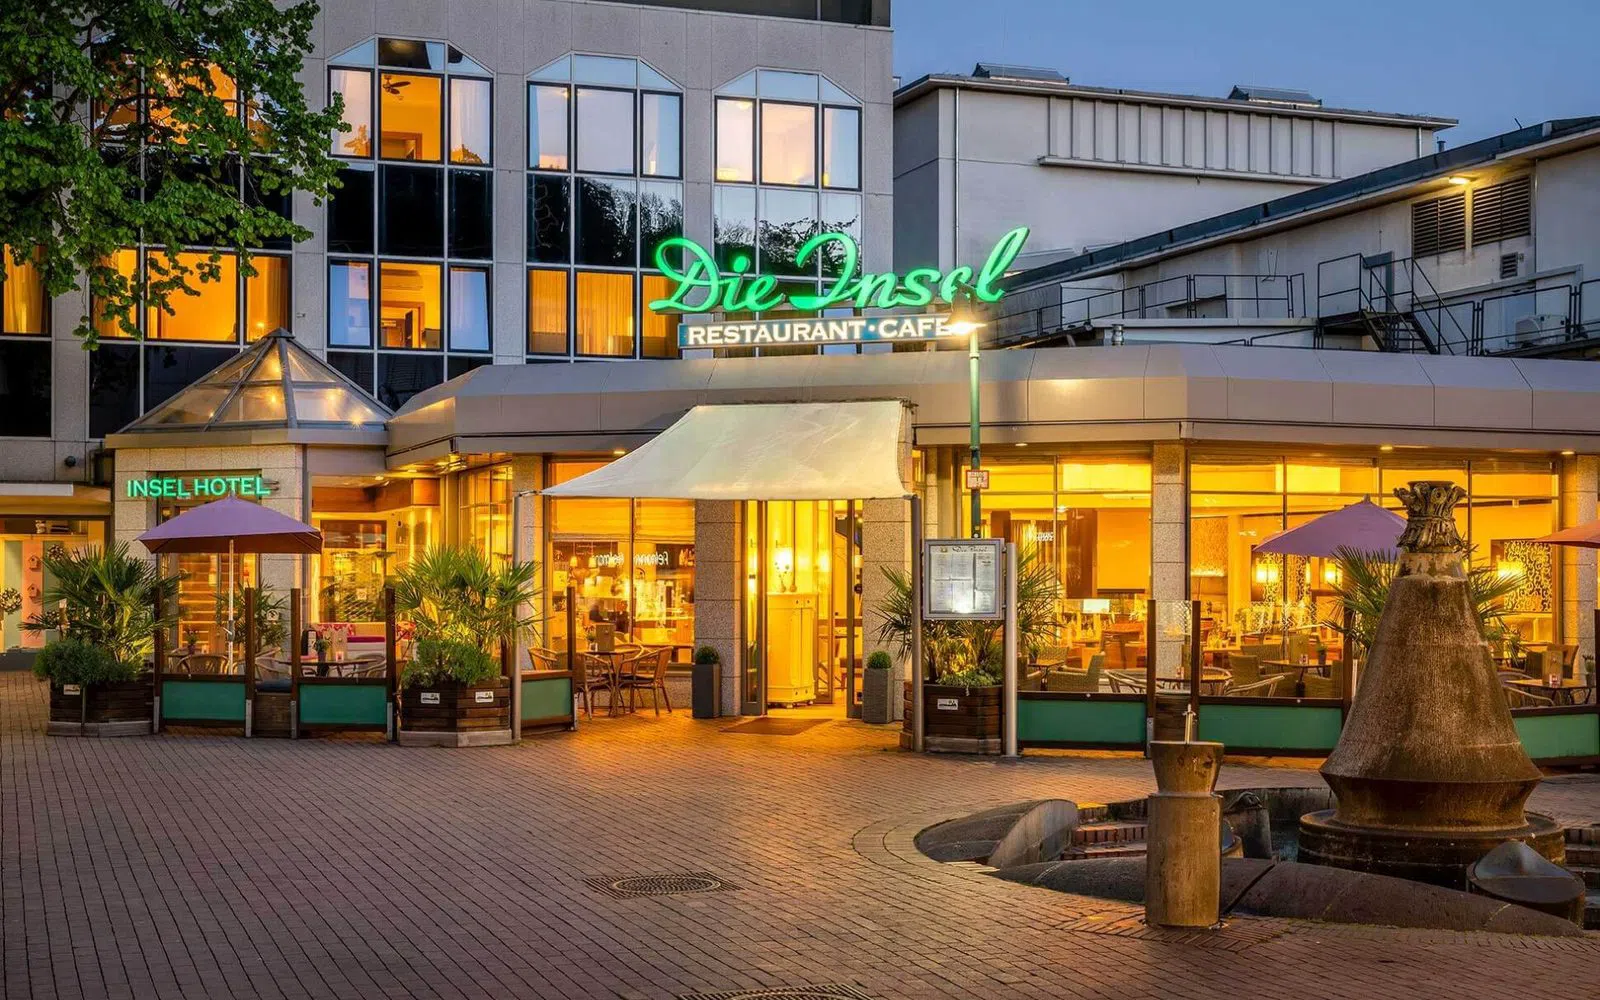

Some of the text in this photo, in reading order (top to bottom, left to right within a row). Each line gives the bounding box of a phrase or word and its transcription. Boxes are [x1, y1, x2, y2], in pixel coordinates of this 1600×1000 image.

[649, 226, 1030, 312] Die Insel
[688, 319, 864, 345] RESTAURANT
[127, 477, 271, 497] INSEL HOTEL
